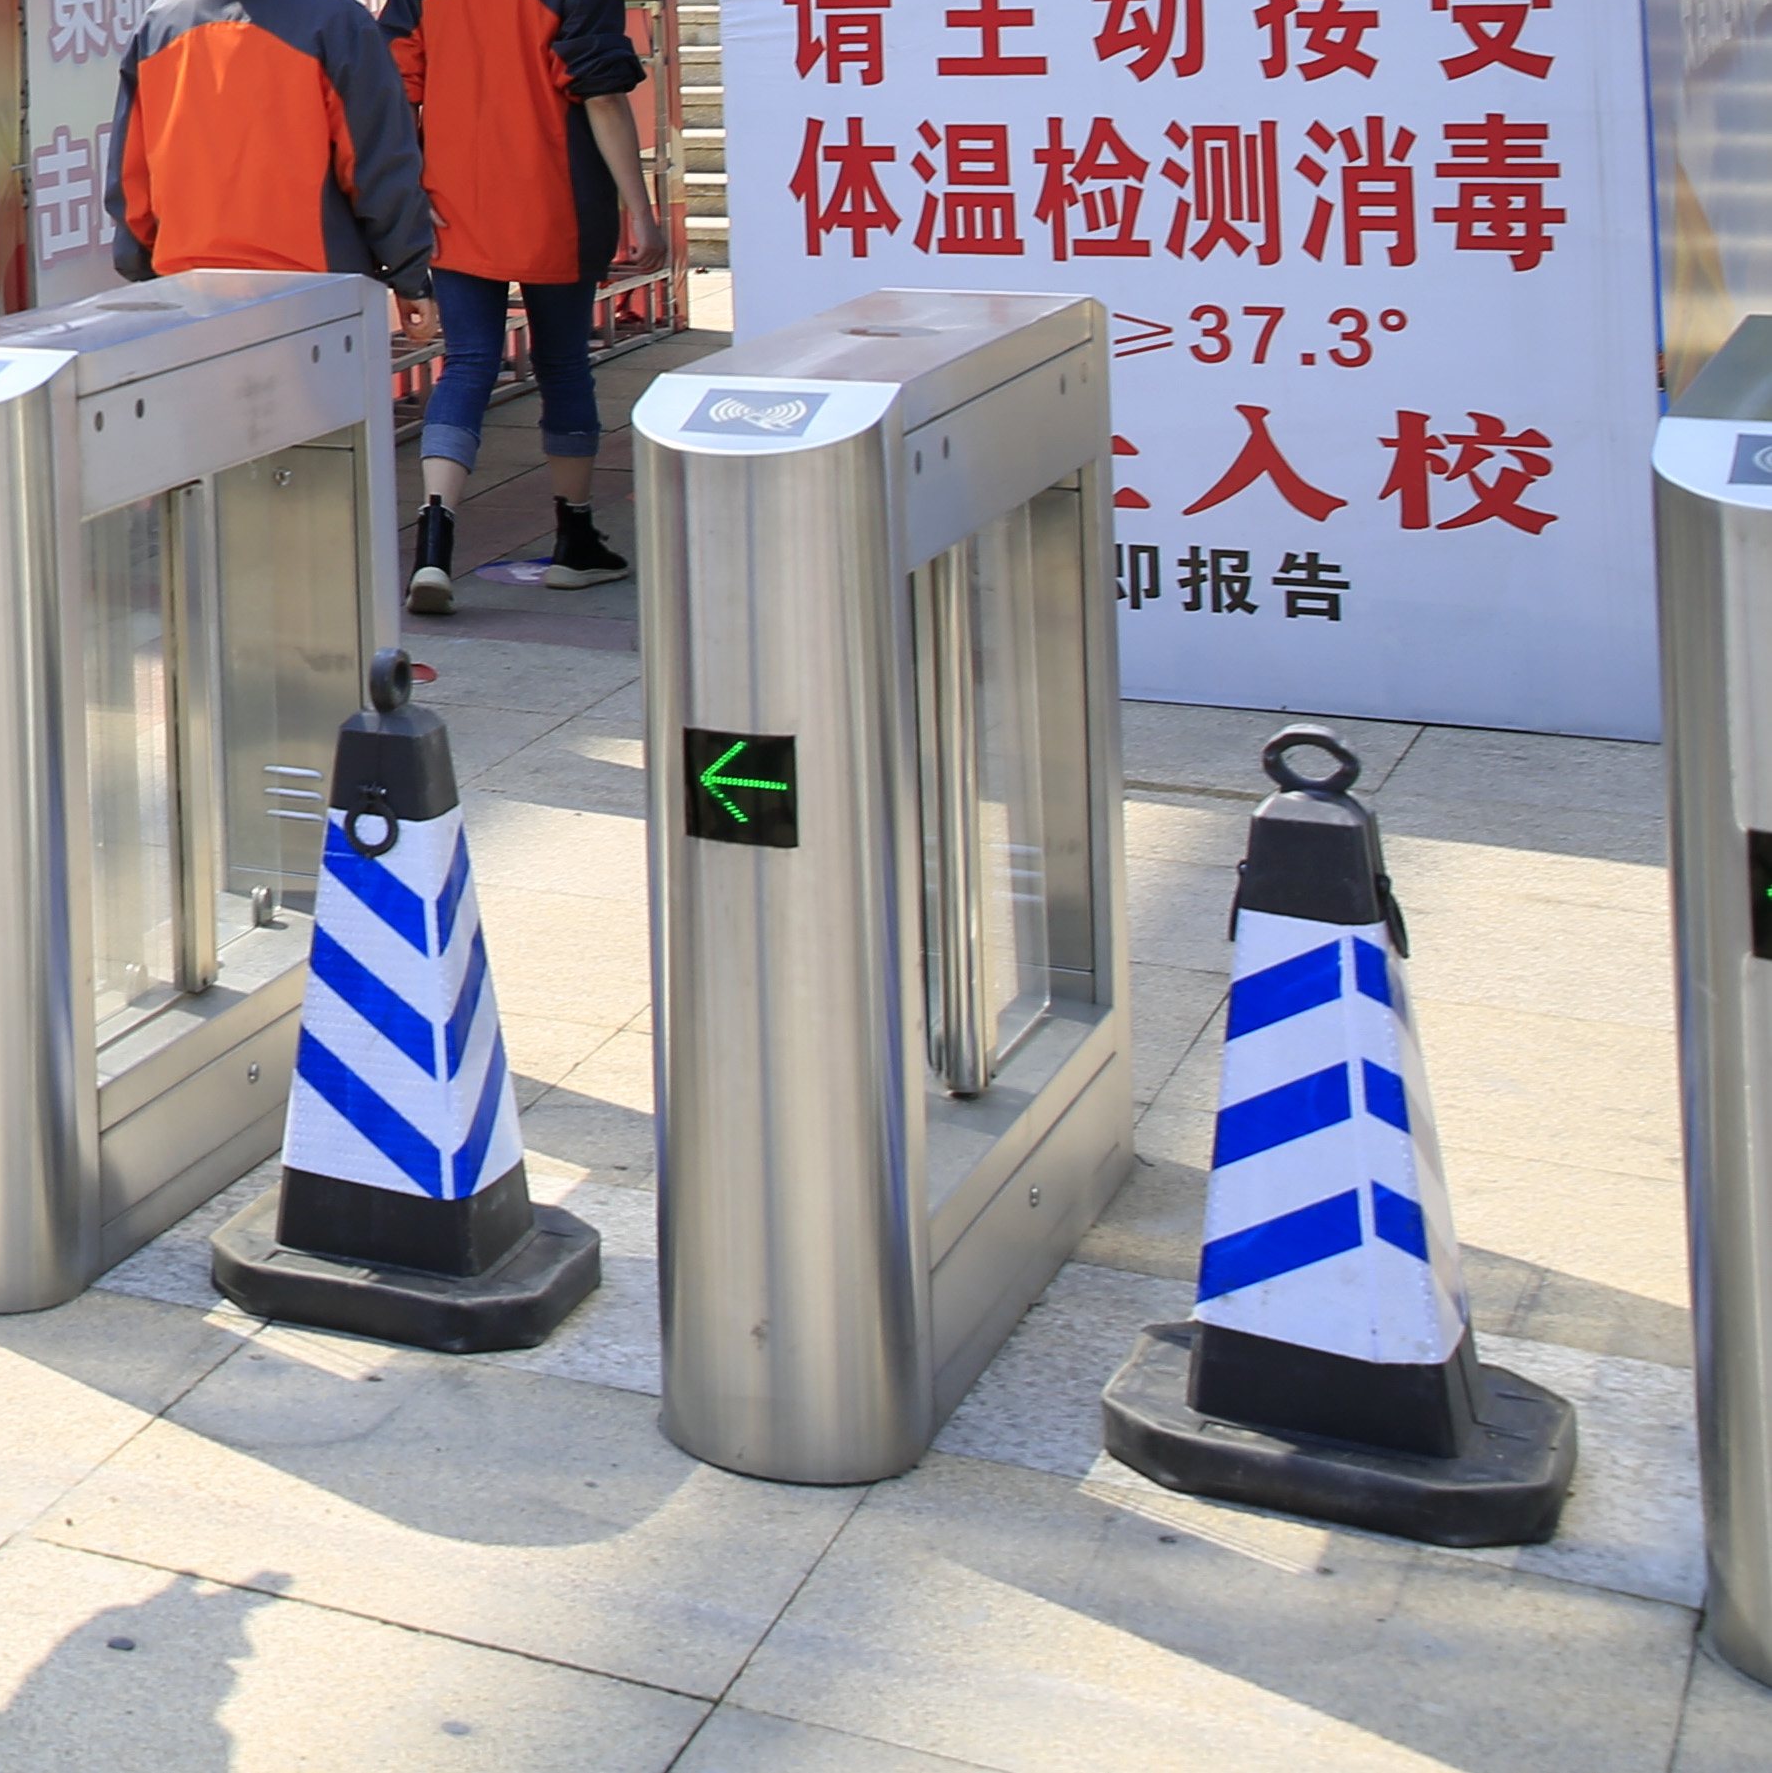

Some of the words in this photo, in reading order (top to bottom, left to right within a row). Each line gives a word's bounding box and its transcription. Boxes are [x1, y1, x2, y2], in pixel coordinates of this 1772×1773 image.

[788, 113, 1568, 272] 体温检测消毒
